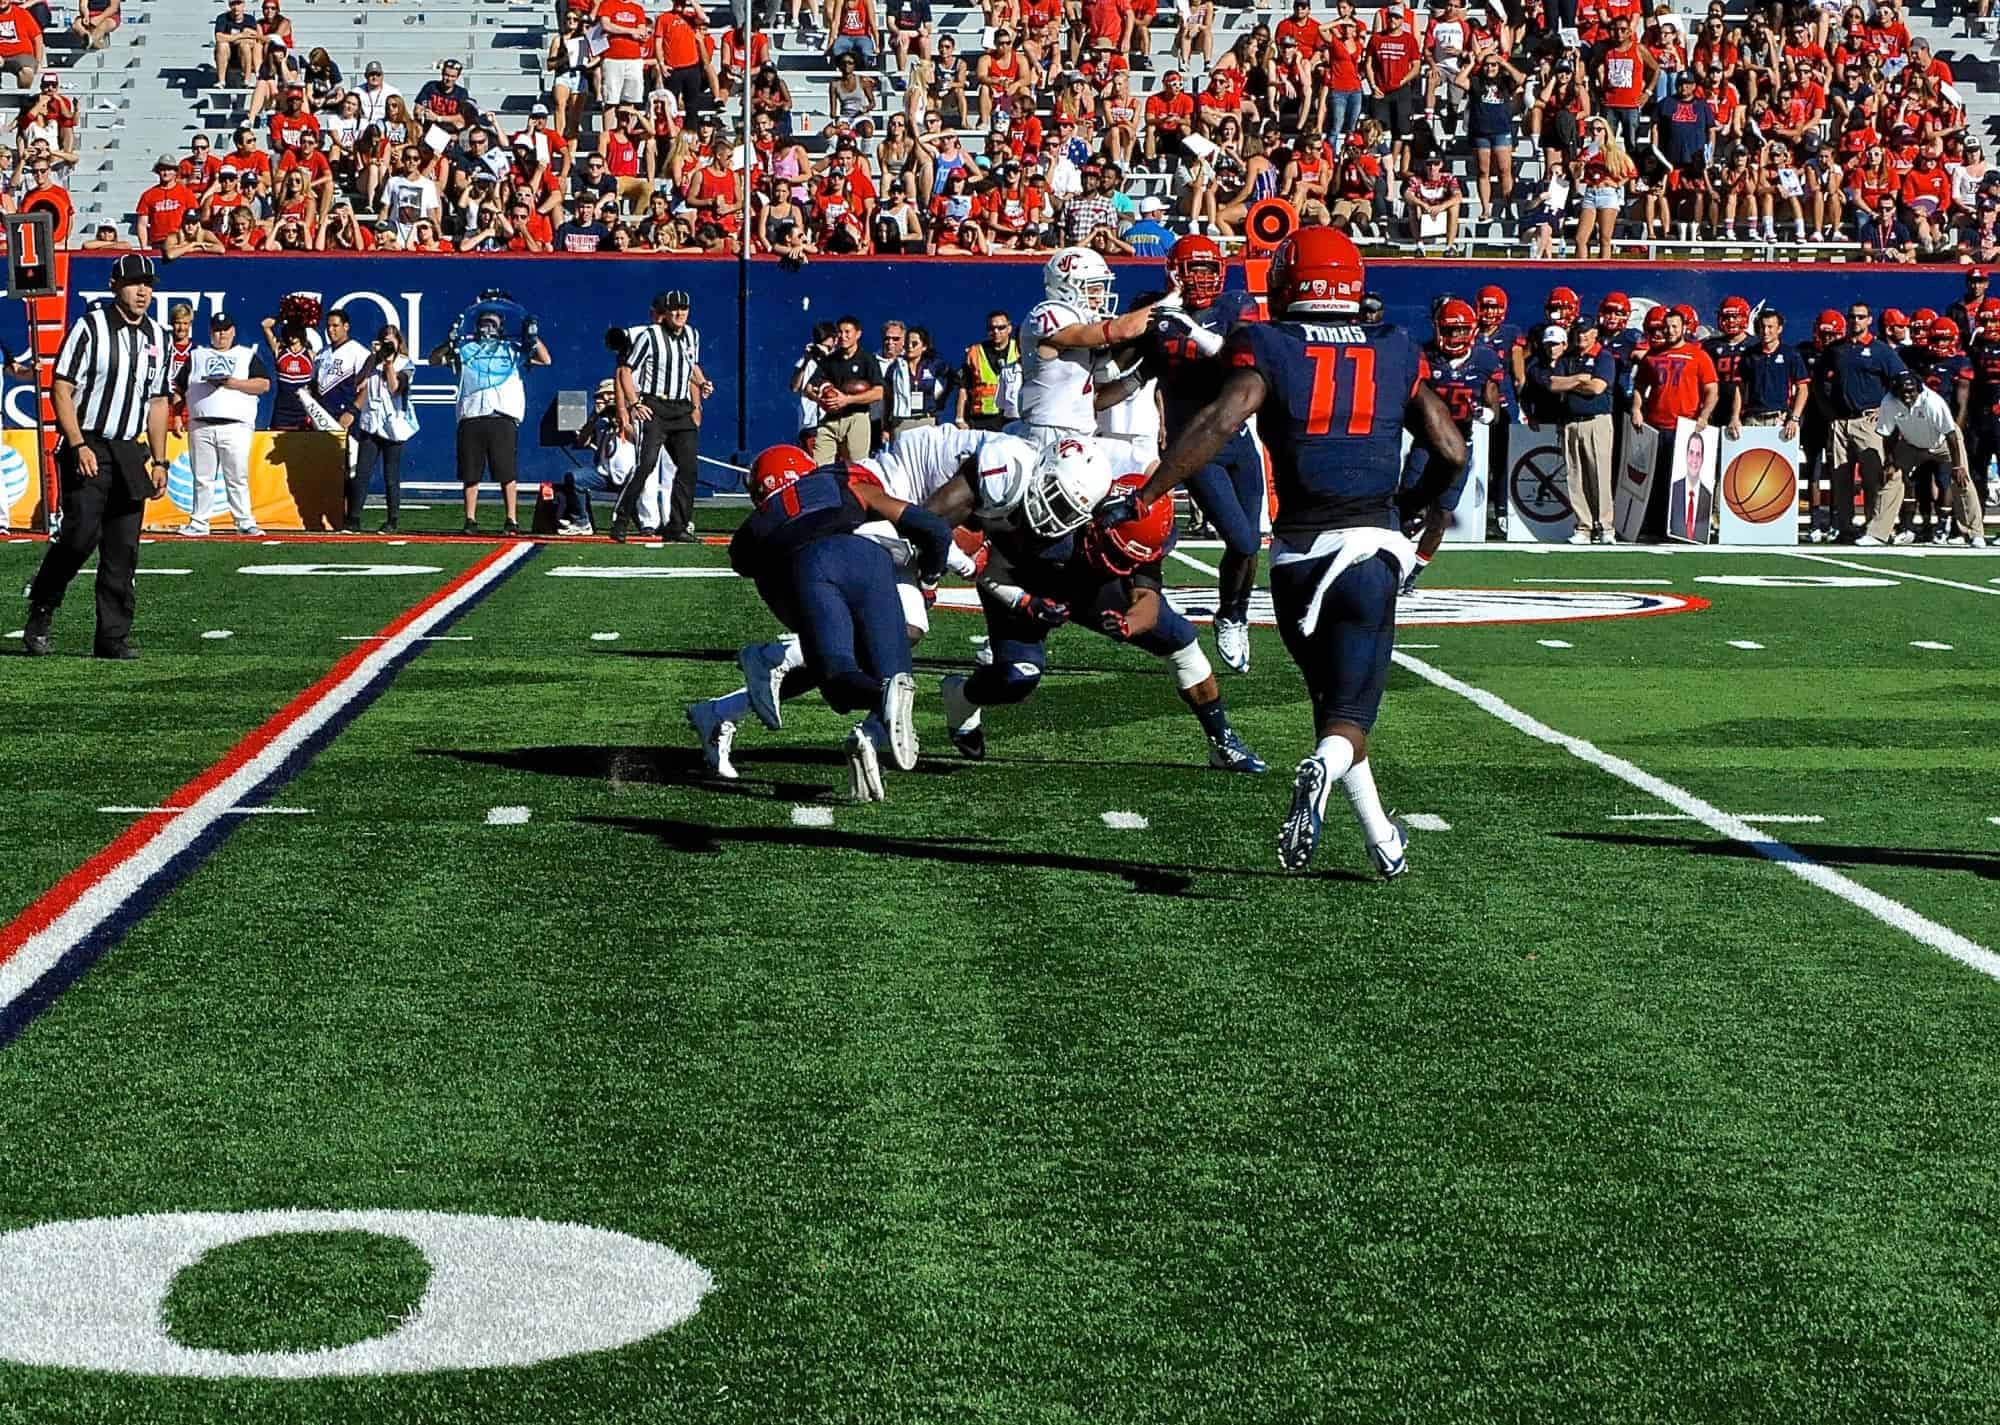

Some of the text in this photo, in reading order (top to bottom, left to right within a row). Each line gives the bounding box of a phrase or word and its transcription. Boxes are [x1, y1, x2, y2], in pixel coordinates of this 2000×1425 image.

[1672, 104, 1697, 122] A
[17, 222, 39, 267] 1
[1039, 310, 1061, 334] 21
[1305, 345, 1377, 435] 11
